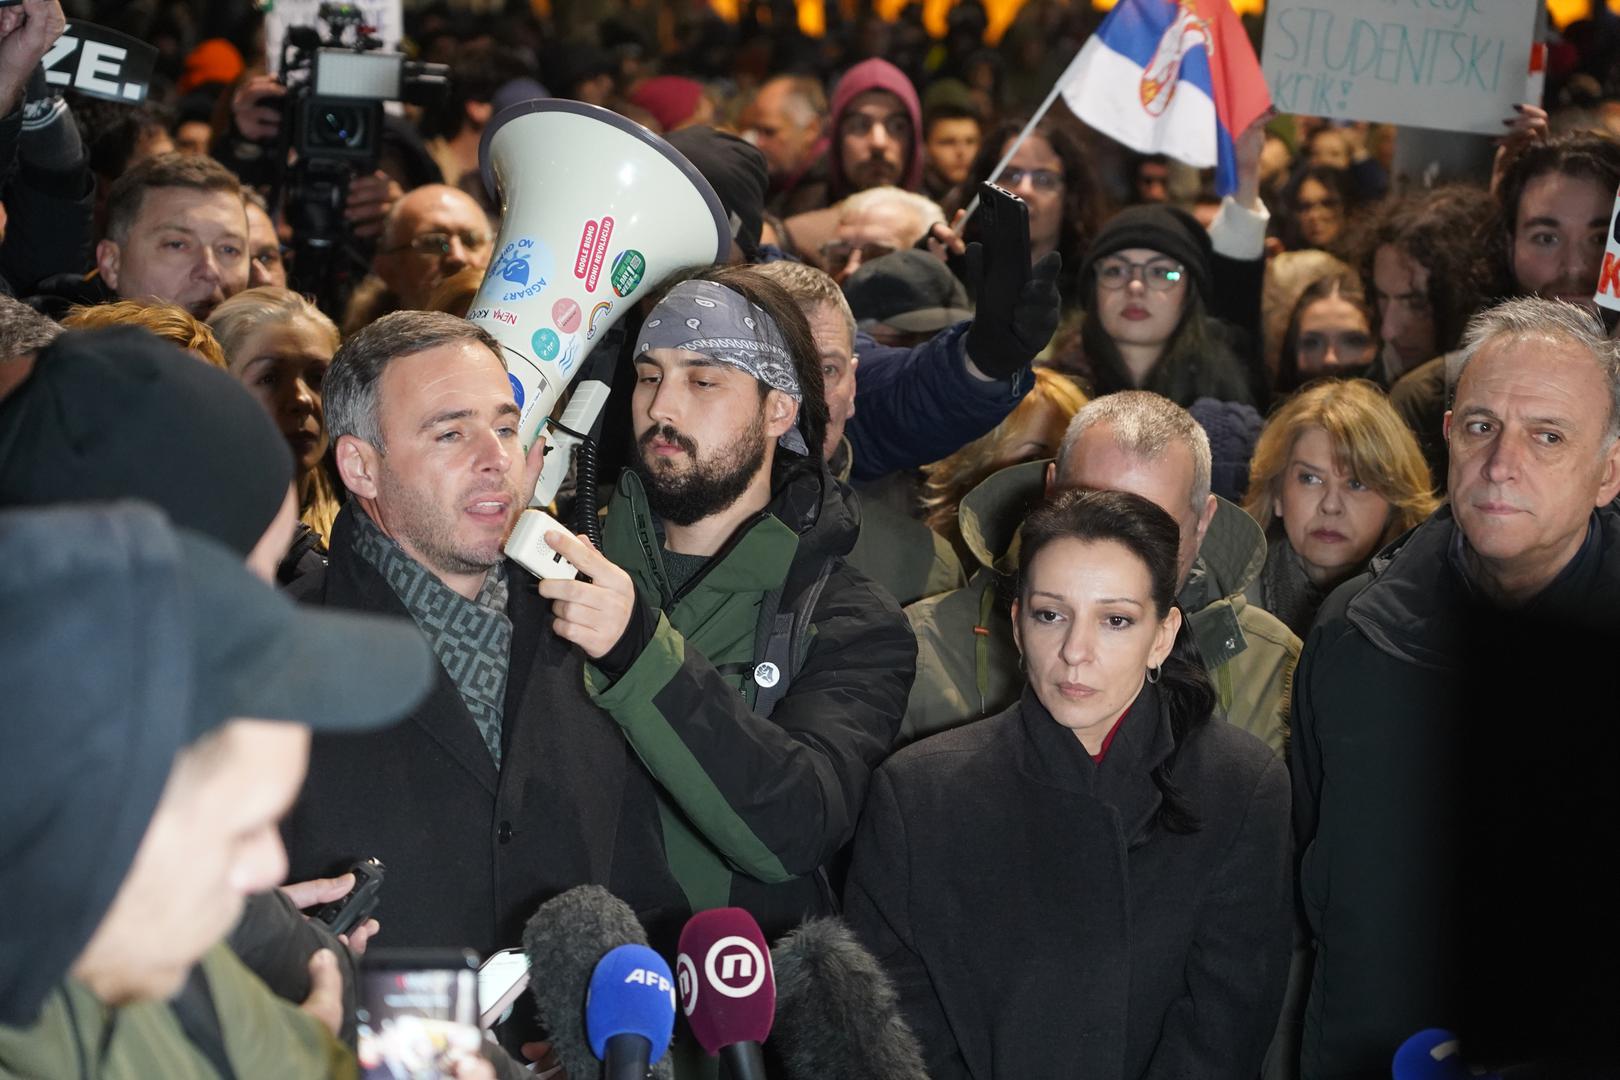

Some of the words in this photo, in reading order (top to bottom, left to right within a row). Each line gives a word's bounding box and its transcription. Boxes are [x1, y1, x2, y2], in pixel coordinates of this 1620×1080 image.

[1273, 7, 1506, 93] STUDENTSKI
[583, 225, 596, 249] BISMO
[577, 248, 590, 274] MOGLE
[588, 264, 600, 289] JEDNU
[594, 220, 612, 265] REVOLUCIJU
[503, 277, 547, 301] AGBAR?
[624, 968, 671, 992] AFP
